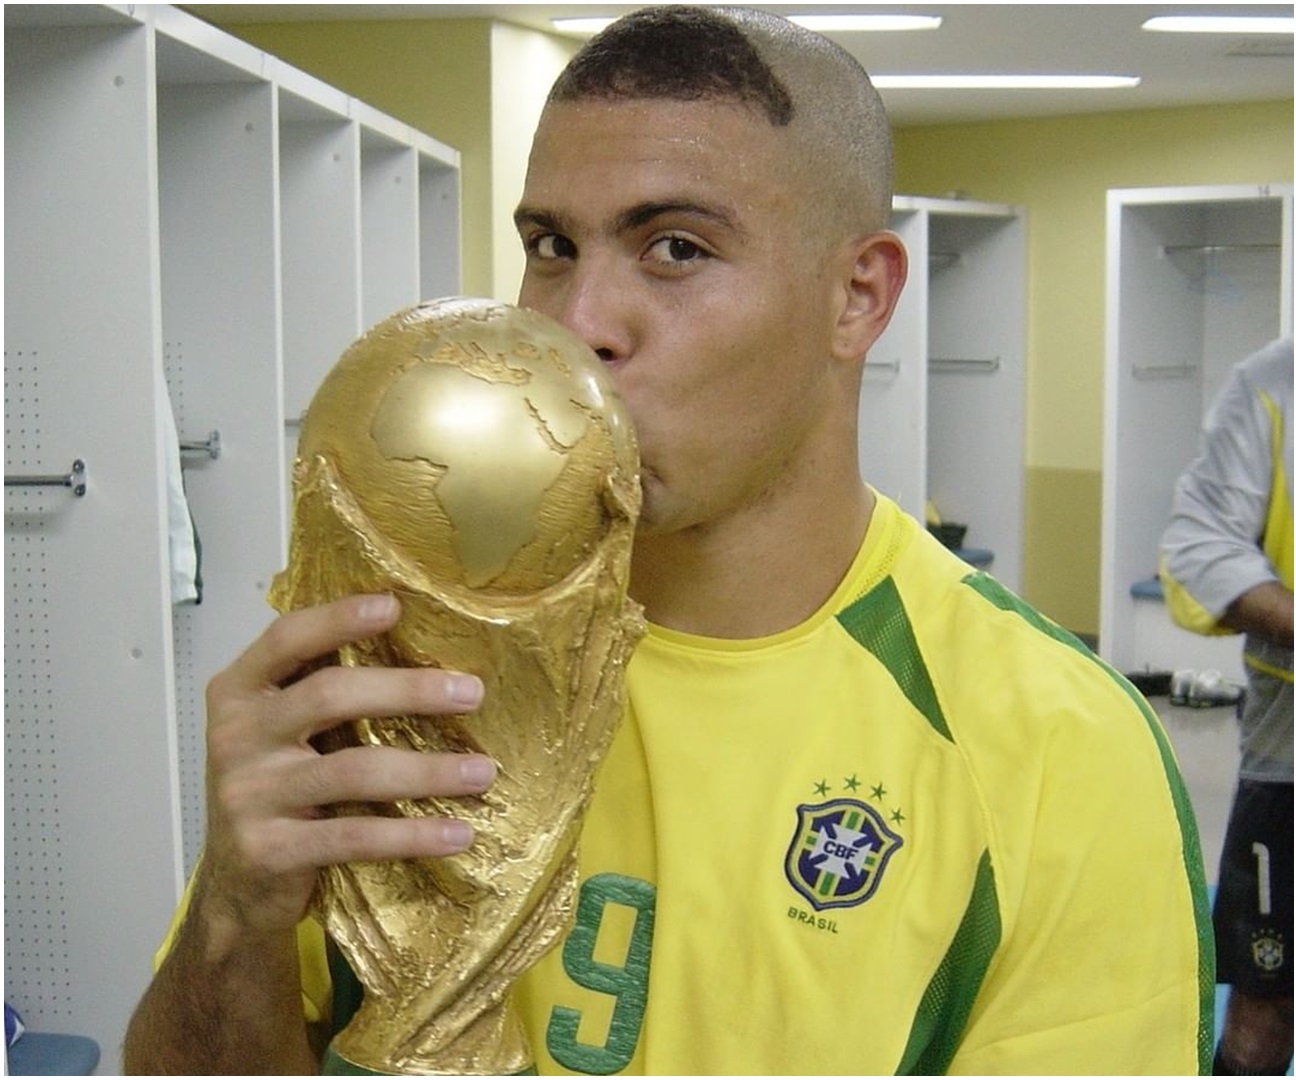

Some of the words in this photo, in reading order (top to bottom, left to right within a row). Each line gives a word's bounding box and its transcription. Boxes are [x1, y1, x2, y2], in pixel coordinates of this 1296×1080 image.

[823, 841, 859, 860] CBF
[1252, 841, 1271, 914] 1
[787, 907, 839, 934] BRASIL
[546, 872, 657, 1076] 9
